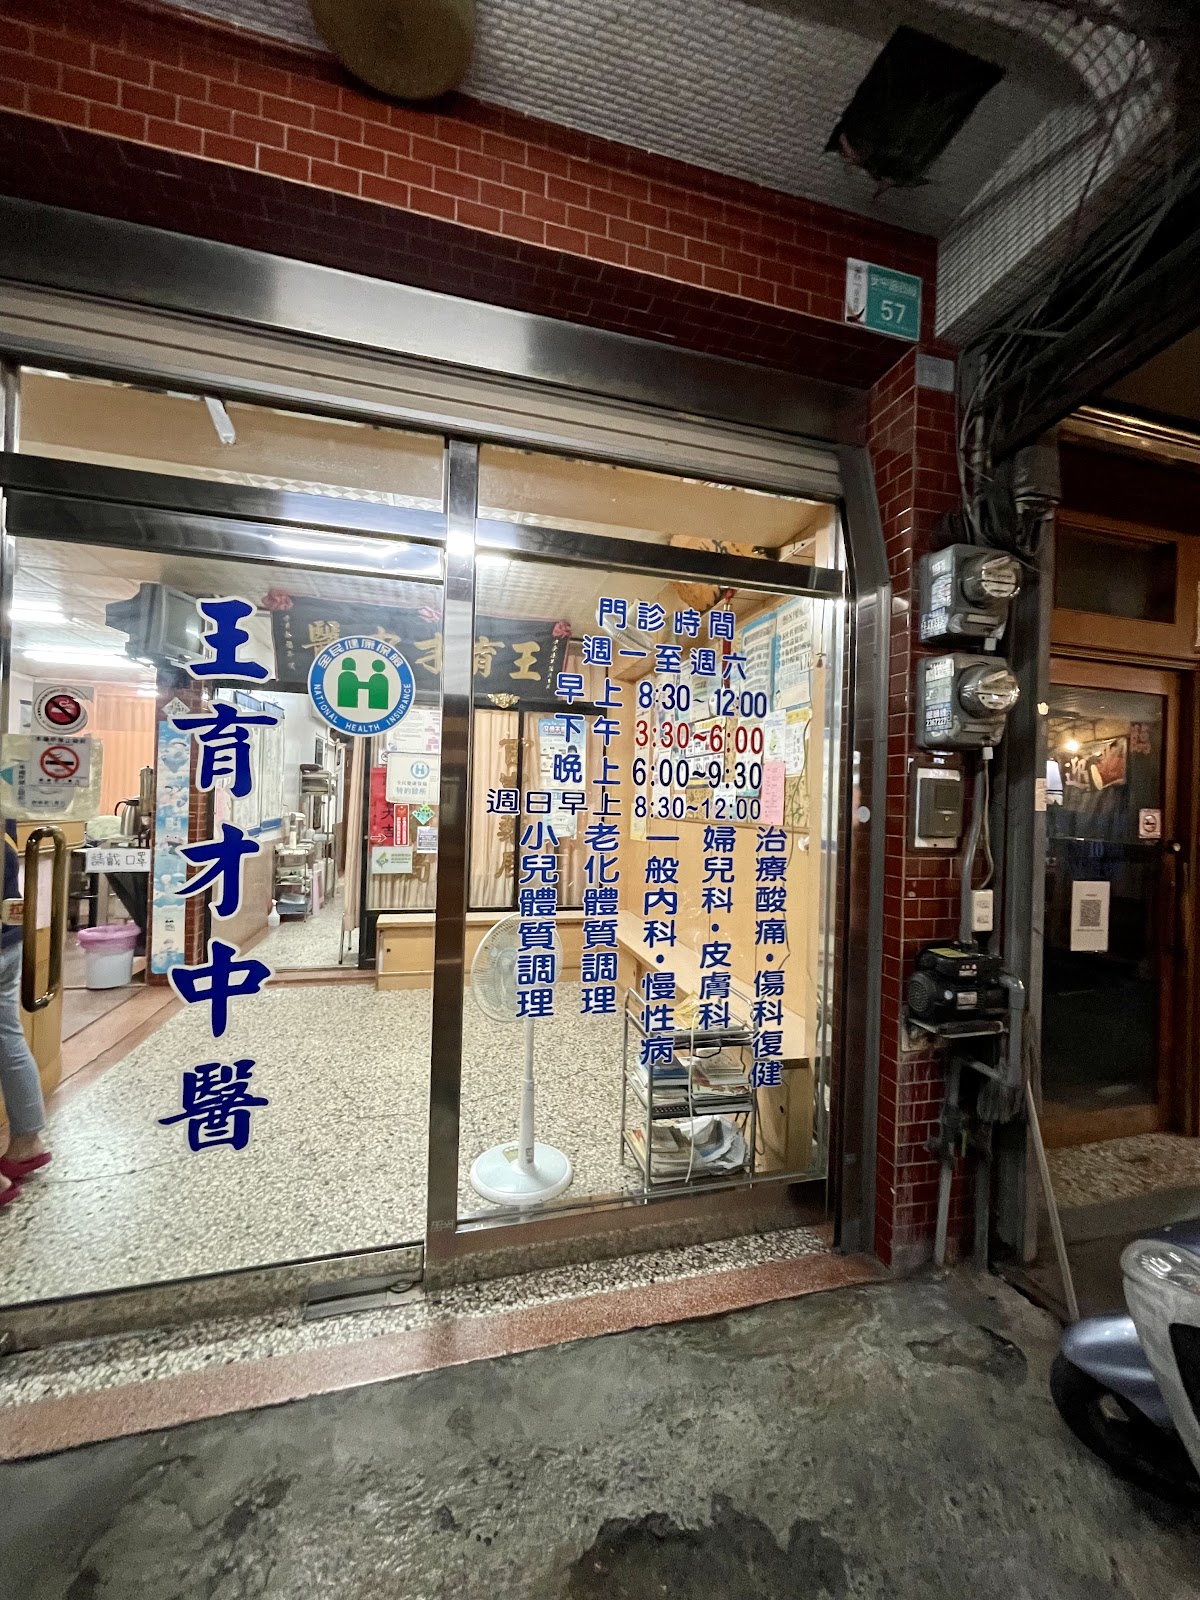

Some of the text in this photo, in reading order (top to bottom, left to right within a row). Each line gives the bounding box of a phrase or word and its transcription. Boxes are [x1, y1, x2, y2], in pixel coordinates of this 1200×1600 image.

[881, 300, 906, 324] 57
[598, 597, 736, 640] 門診時間
[318, 636, 404, 669] 全民健康保險
[582, 634, 747, 681] 週一至週六
[557, 674, 622, 706] 早上
[313, 683, 339, 725] NATIONAL
[345, 721, 380, 734] HEALTH
[386, 683, 412, 726] INSURANCE
[556, 715, 619, 745] 下午
[554, 754, 620, 784] 晚上
[486, 789, 758, 819] 週日早上 8:30~12:00
[91, 851, 148, 868] 請戴口罩
[160, 598, 279, 1152] 王育才中醫
[516, 822, 558, 1018] 小兒體質調理
[581, 823, 621, 1014] 老化體質調理
